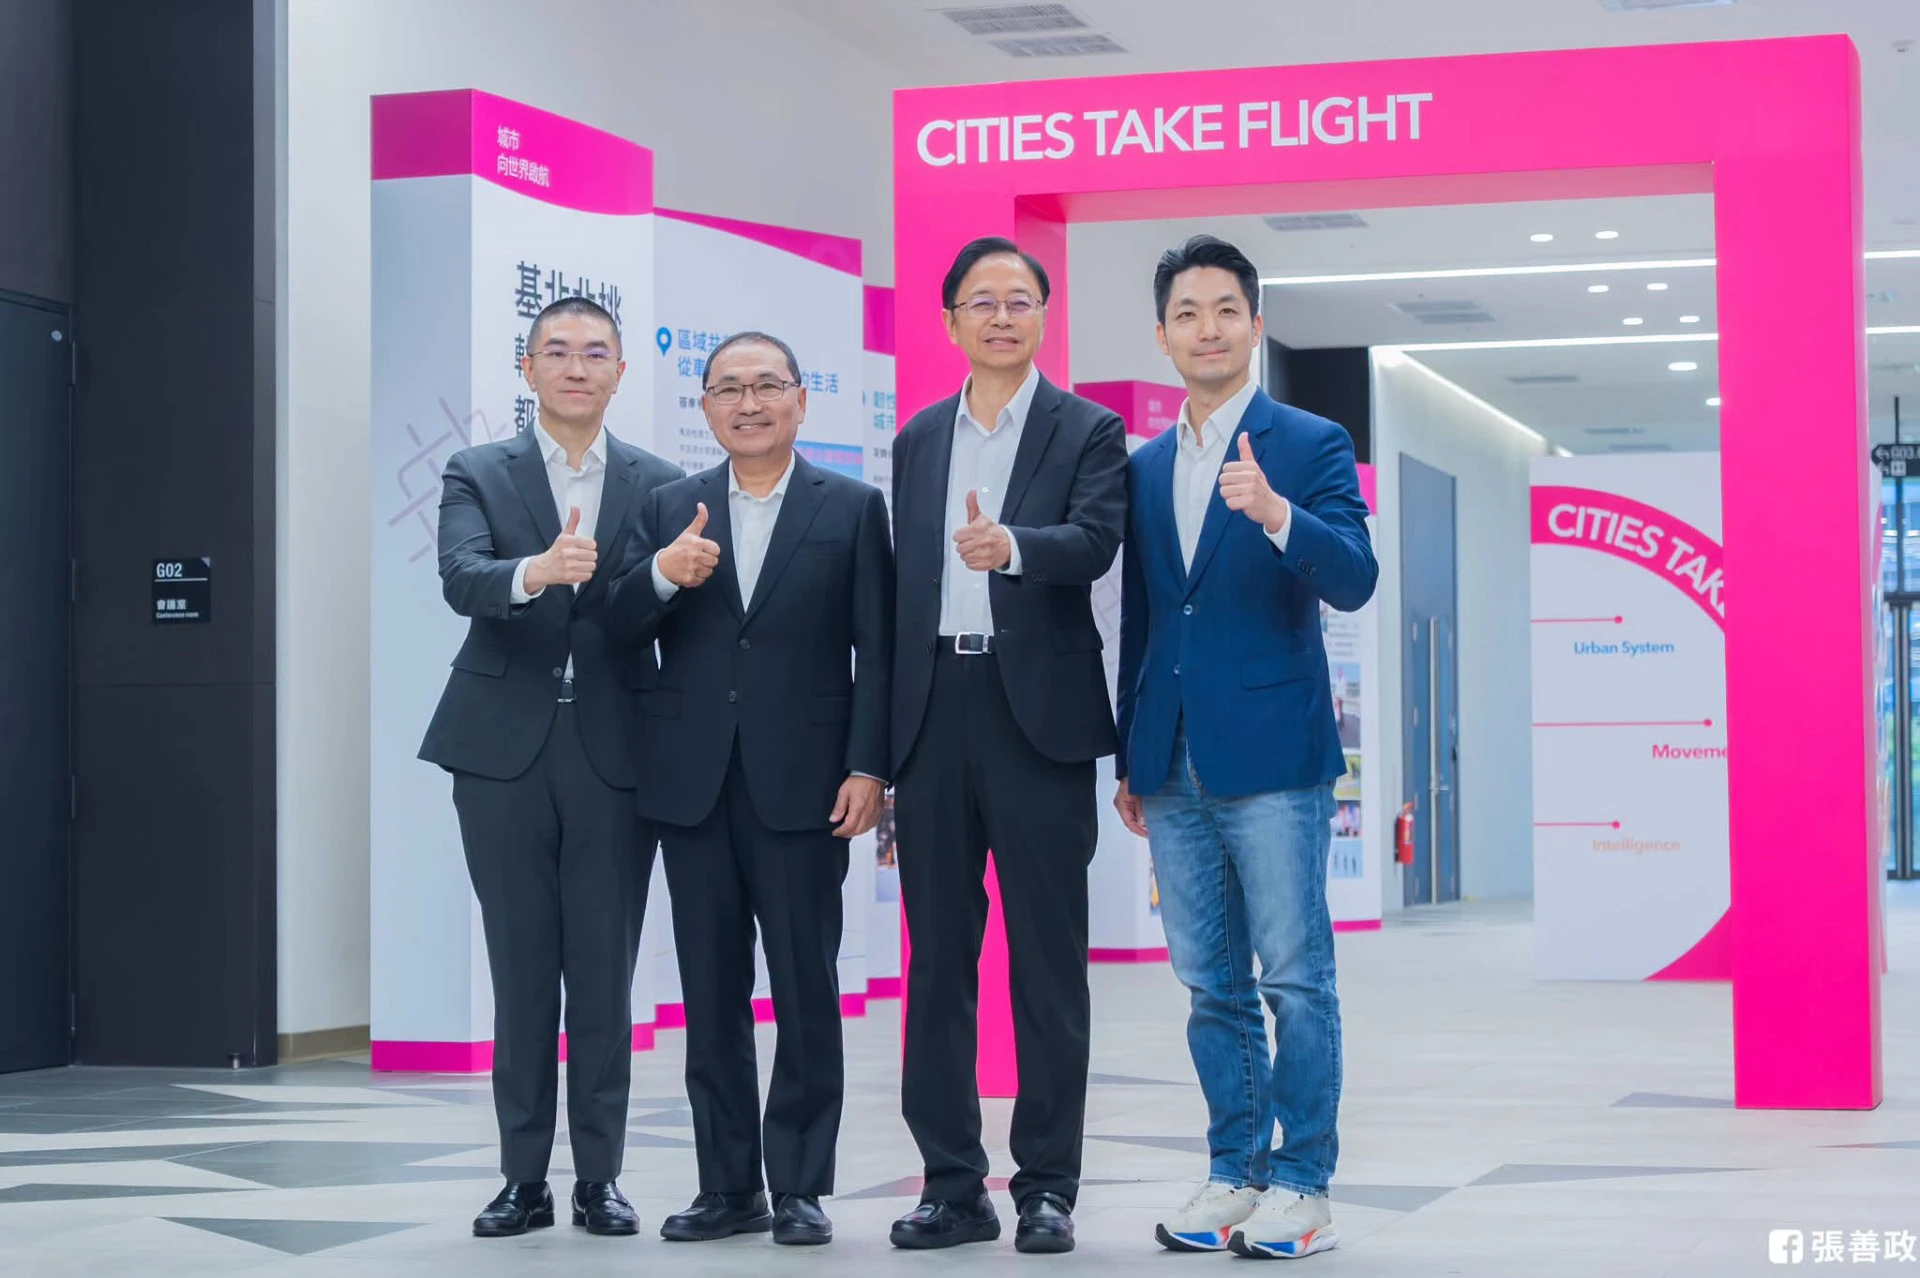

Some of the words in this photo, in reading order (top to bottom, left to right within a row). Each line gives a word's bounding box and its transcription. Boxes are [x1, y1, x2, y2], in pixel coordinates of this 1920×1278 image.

[497, 124, 521, 150] 城市
[916, 112, 1075, 166] CITIES
[1084, 105, 1225, 156] TAKE
[1238, 93, 1433, 148] FLIGHT
[156, 563, 182, 578] G02
[1548, 503, 1664, 559] CITIES
[1665, 536, 1725, 620] TAK
[1574, 641, 1618, 654] Urban
[1622, 641, 1675, 657] System
[1592, 837, 1680, 855] Intelligence
